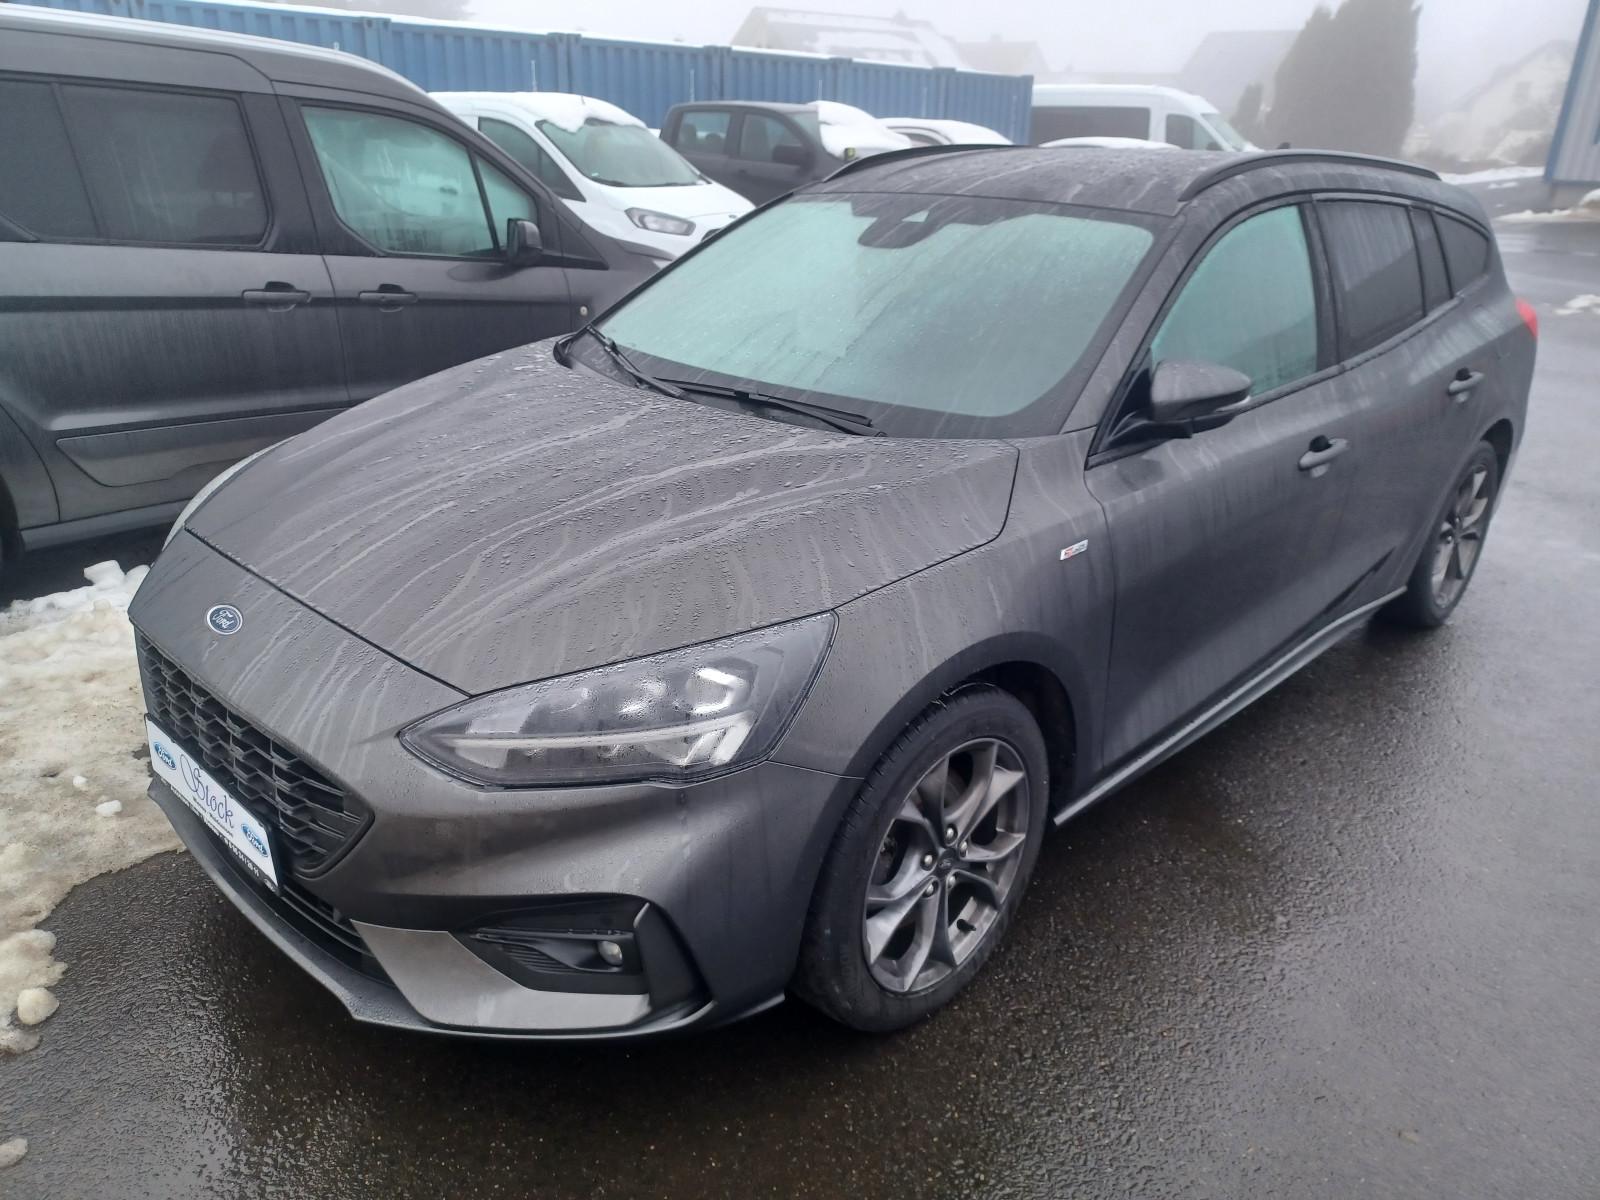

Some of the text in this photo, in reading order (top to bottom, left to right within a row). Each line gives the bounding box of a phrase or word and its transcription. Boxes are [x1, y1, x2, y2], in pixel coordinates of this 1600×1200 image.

[211, 608, 236, 631] Ford
[156, 744, 174, 768] Ford
[246, 830, 265, 854] Ford
